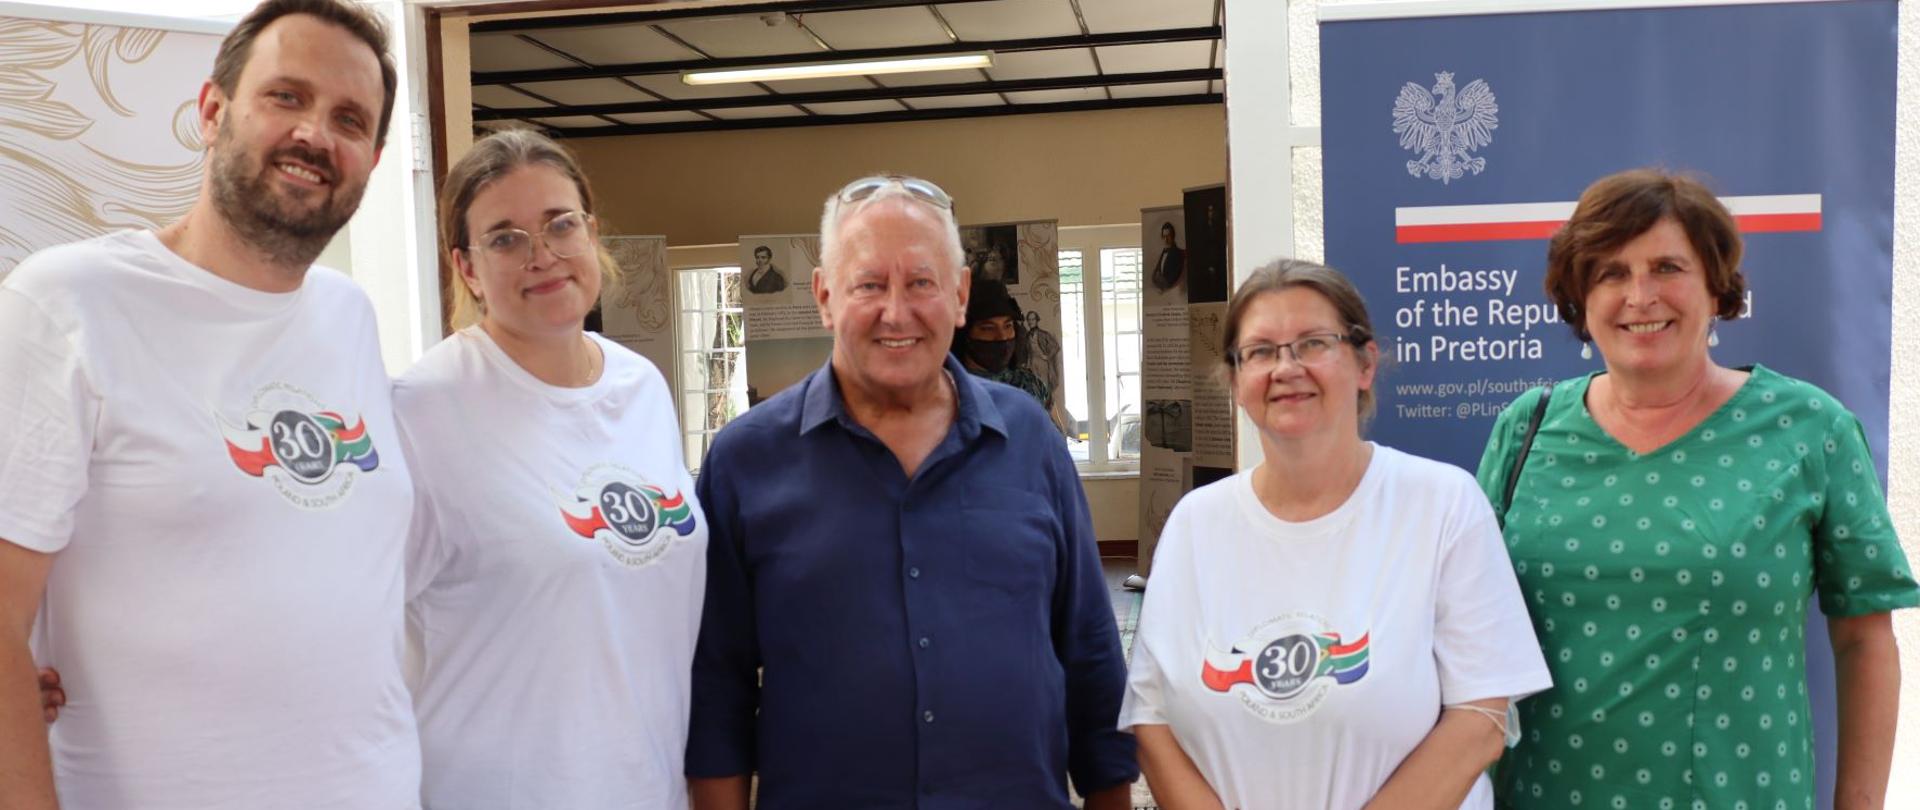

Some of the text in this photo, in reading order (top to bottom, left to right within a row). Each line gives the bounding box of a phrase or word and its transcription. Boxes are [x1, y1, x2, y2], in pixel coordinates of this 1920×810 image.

[1396, 264, 1518, 296] Embassy
[1396, 299, 1562, 330] of the Repu
[1397, 333, 1542, 362] in Pretoria
[1396, 402, 1511, 419] Twitter: @PLinS
[273, 421, 323, 460] 30
[603, 491, 649, 523] 30
[621, 524, 649, 534] YEARS
[1262, 641, 1310, 679] 30
[1272, 678, 1301, 688] YEARS
